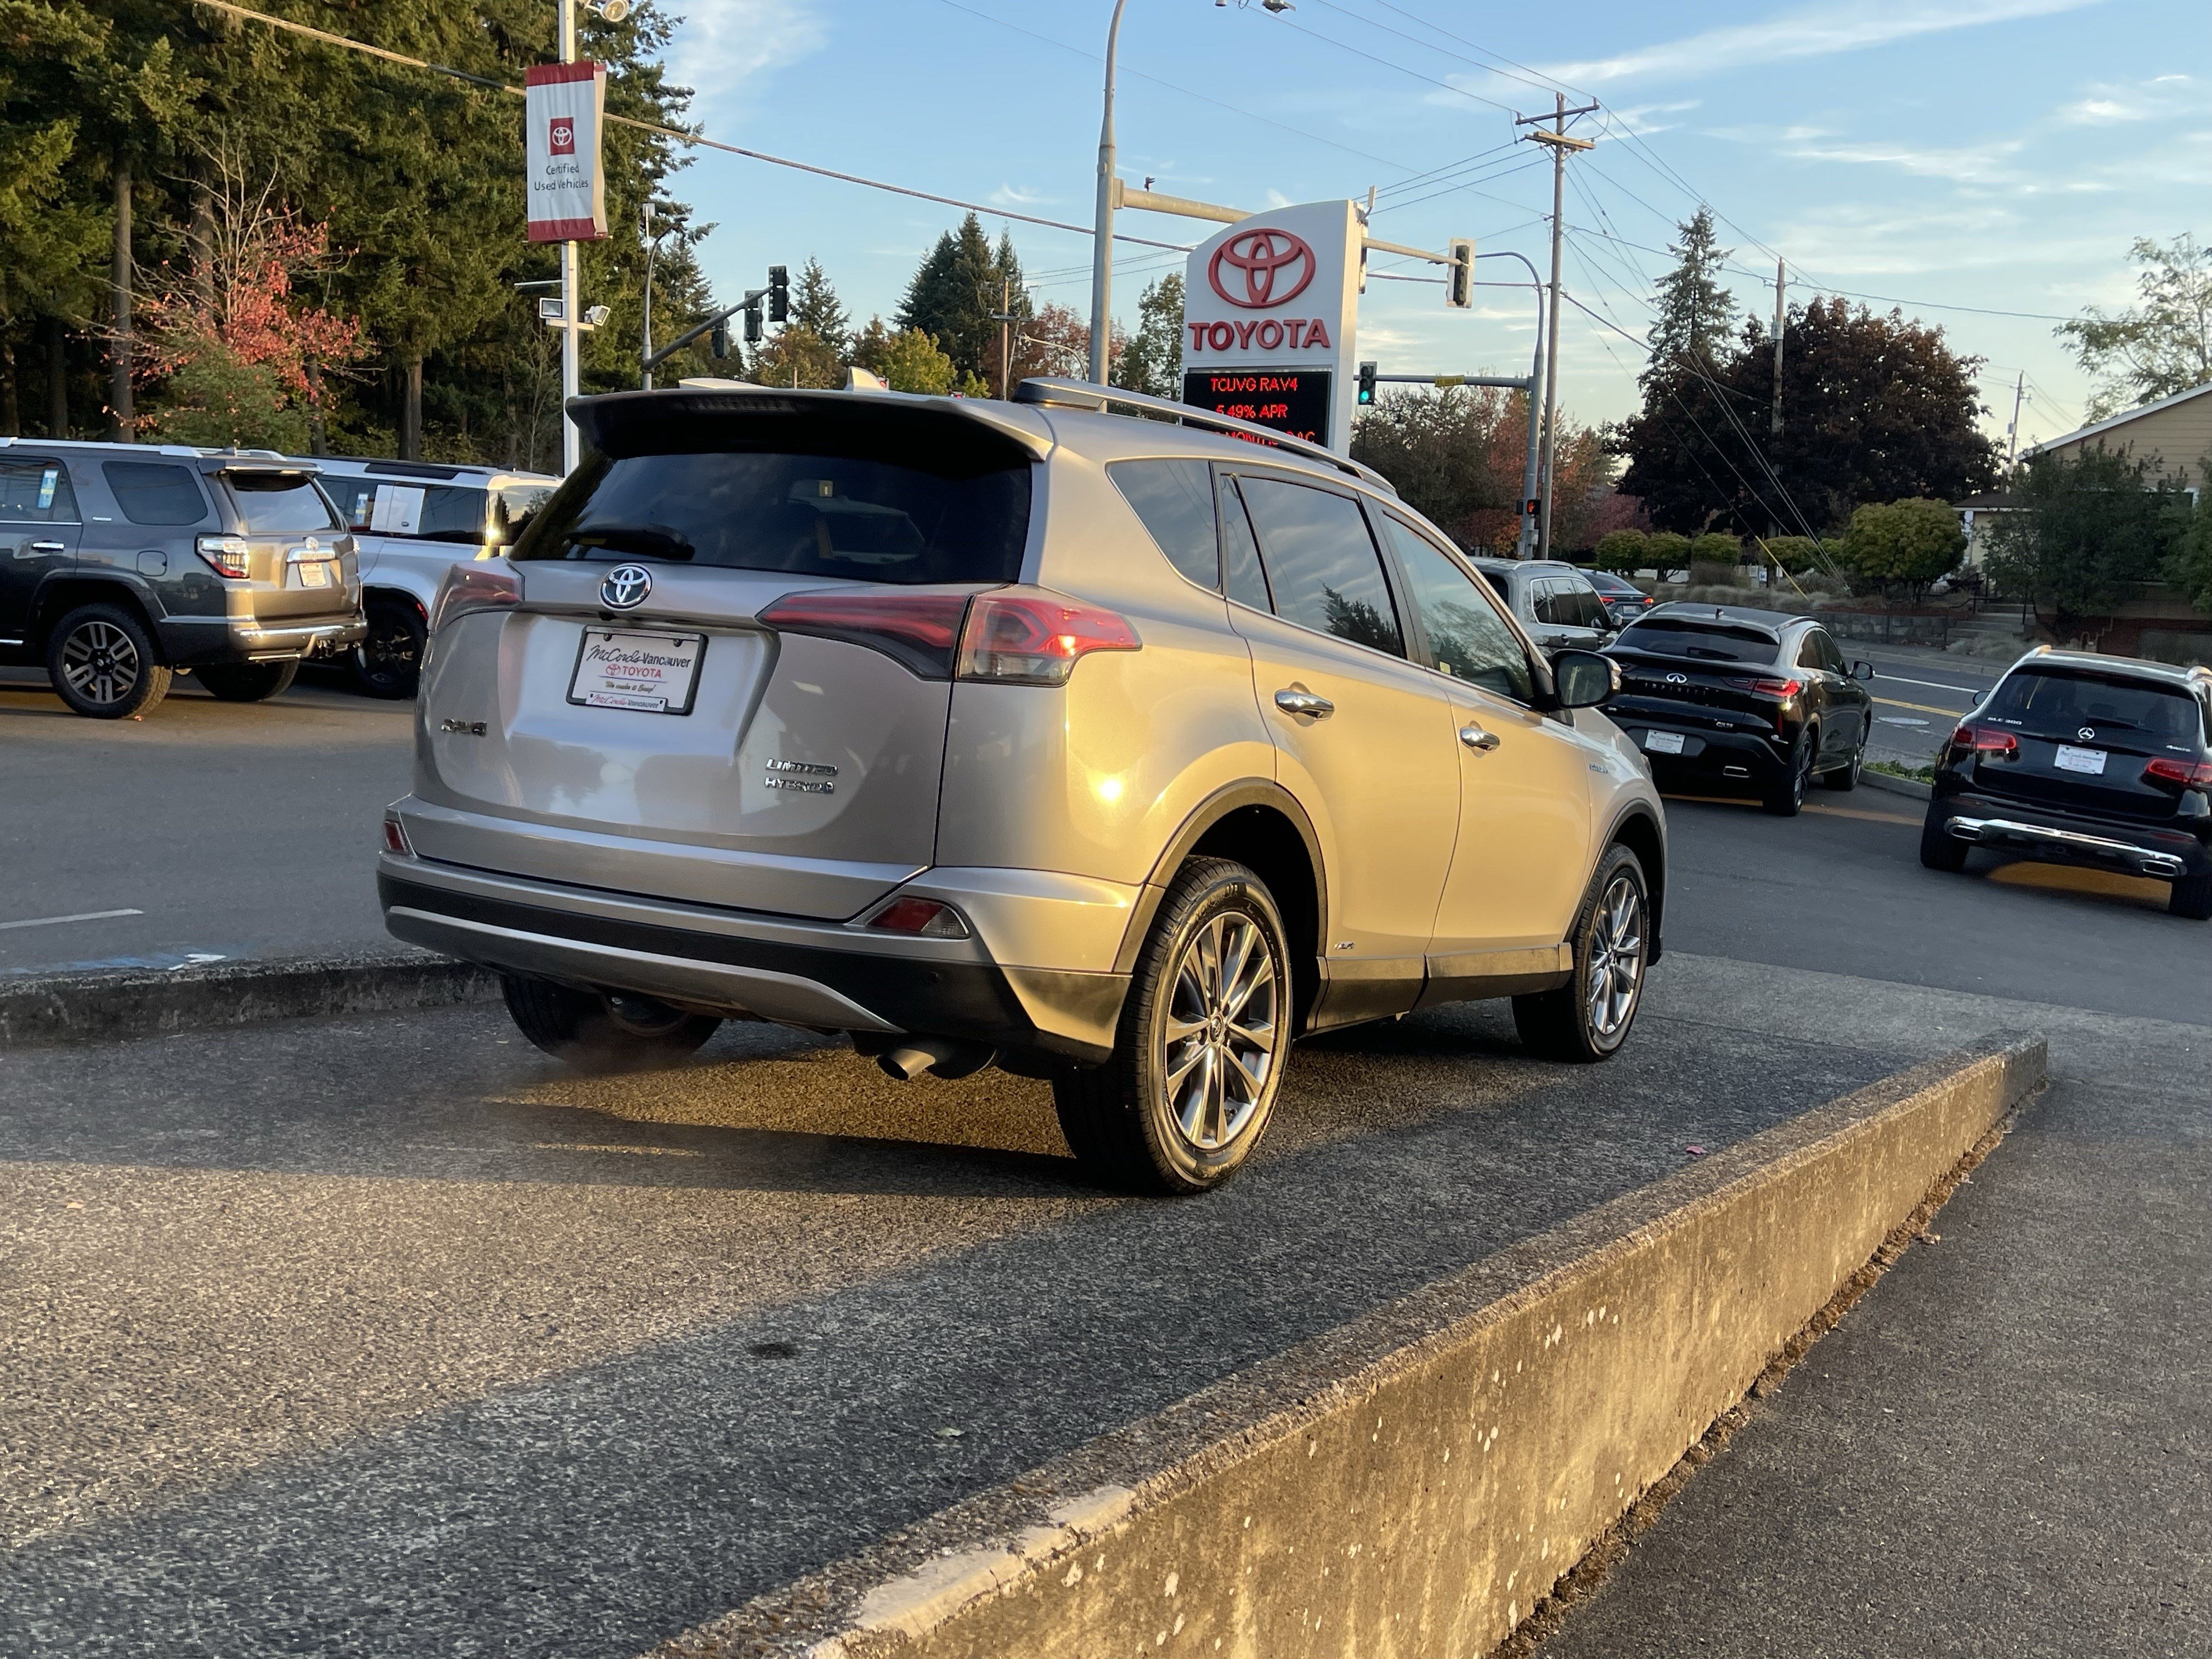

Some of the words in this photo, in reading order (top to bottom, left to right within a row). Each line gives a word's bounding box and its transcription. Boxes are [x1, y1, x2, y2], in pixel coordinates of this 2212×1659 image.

[546, 161, 579, 175] Certified
[534, 179, 556, 191] Used
[556, 177, 589, 189] Vehicles
[1188, 318, 1331, 352] TOYOTA
[1260, 376, 1299, 392] RAV4
[1215, 404, 1256, 419] 549%
[1259, 403, 1288, 419] APR
[623, 665, 662, 679] TOYOTA
